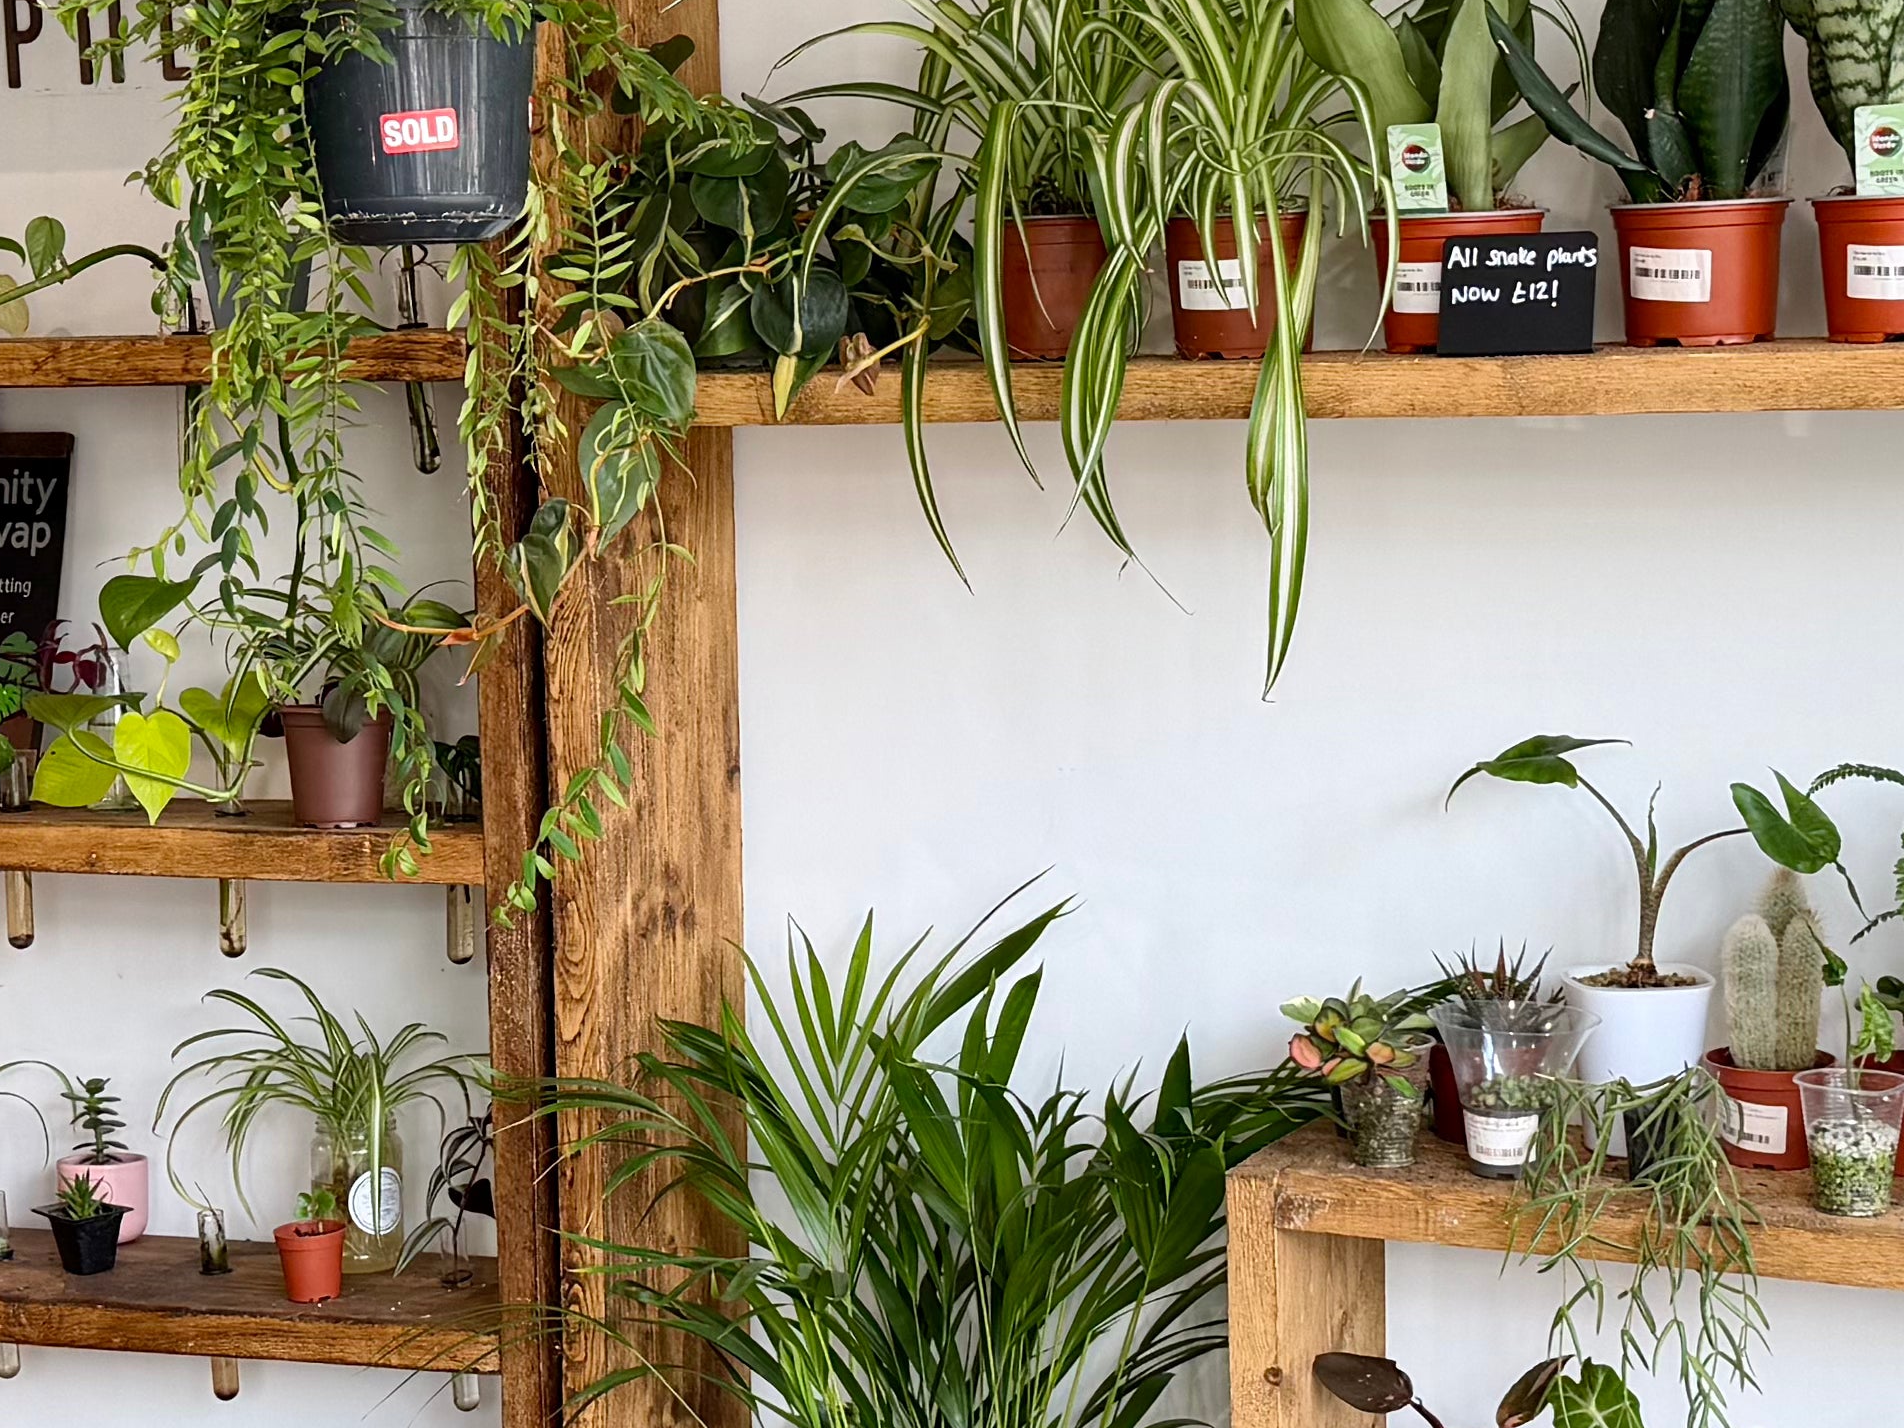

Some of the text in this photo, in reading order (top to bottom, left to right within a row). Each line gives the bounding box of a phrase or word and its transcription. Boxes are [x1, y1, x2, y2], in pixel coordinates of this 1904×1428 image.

[383, 115, 454, 148] SOLD
[1447, 245, 1597, 272] All snake plants
[1511, 279, 1559, 308] £12!
